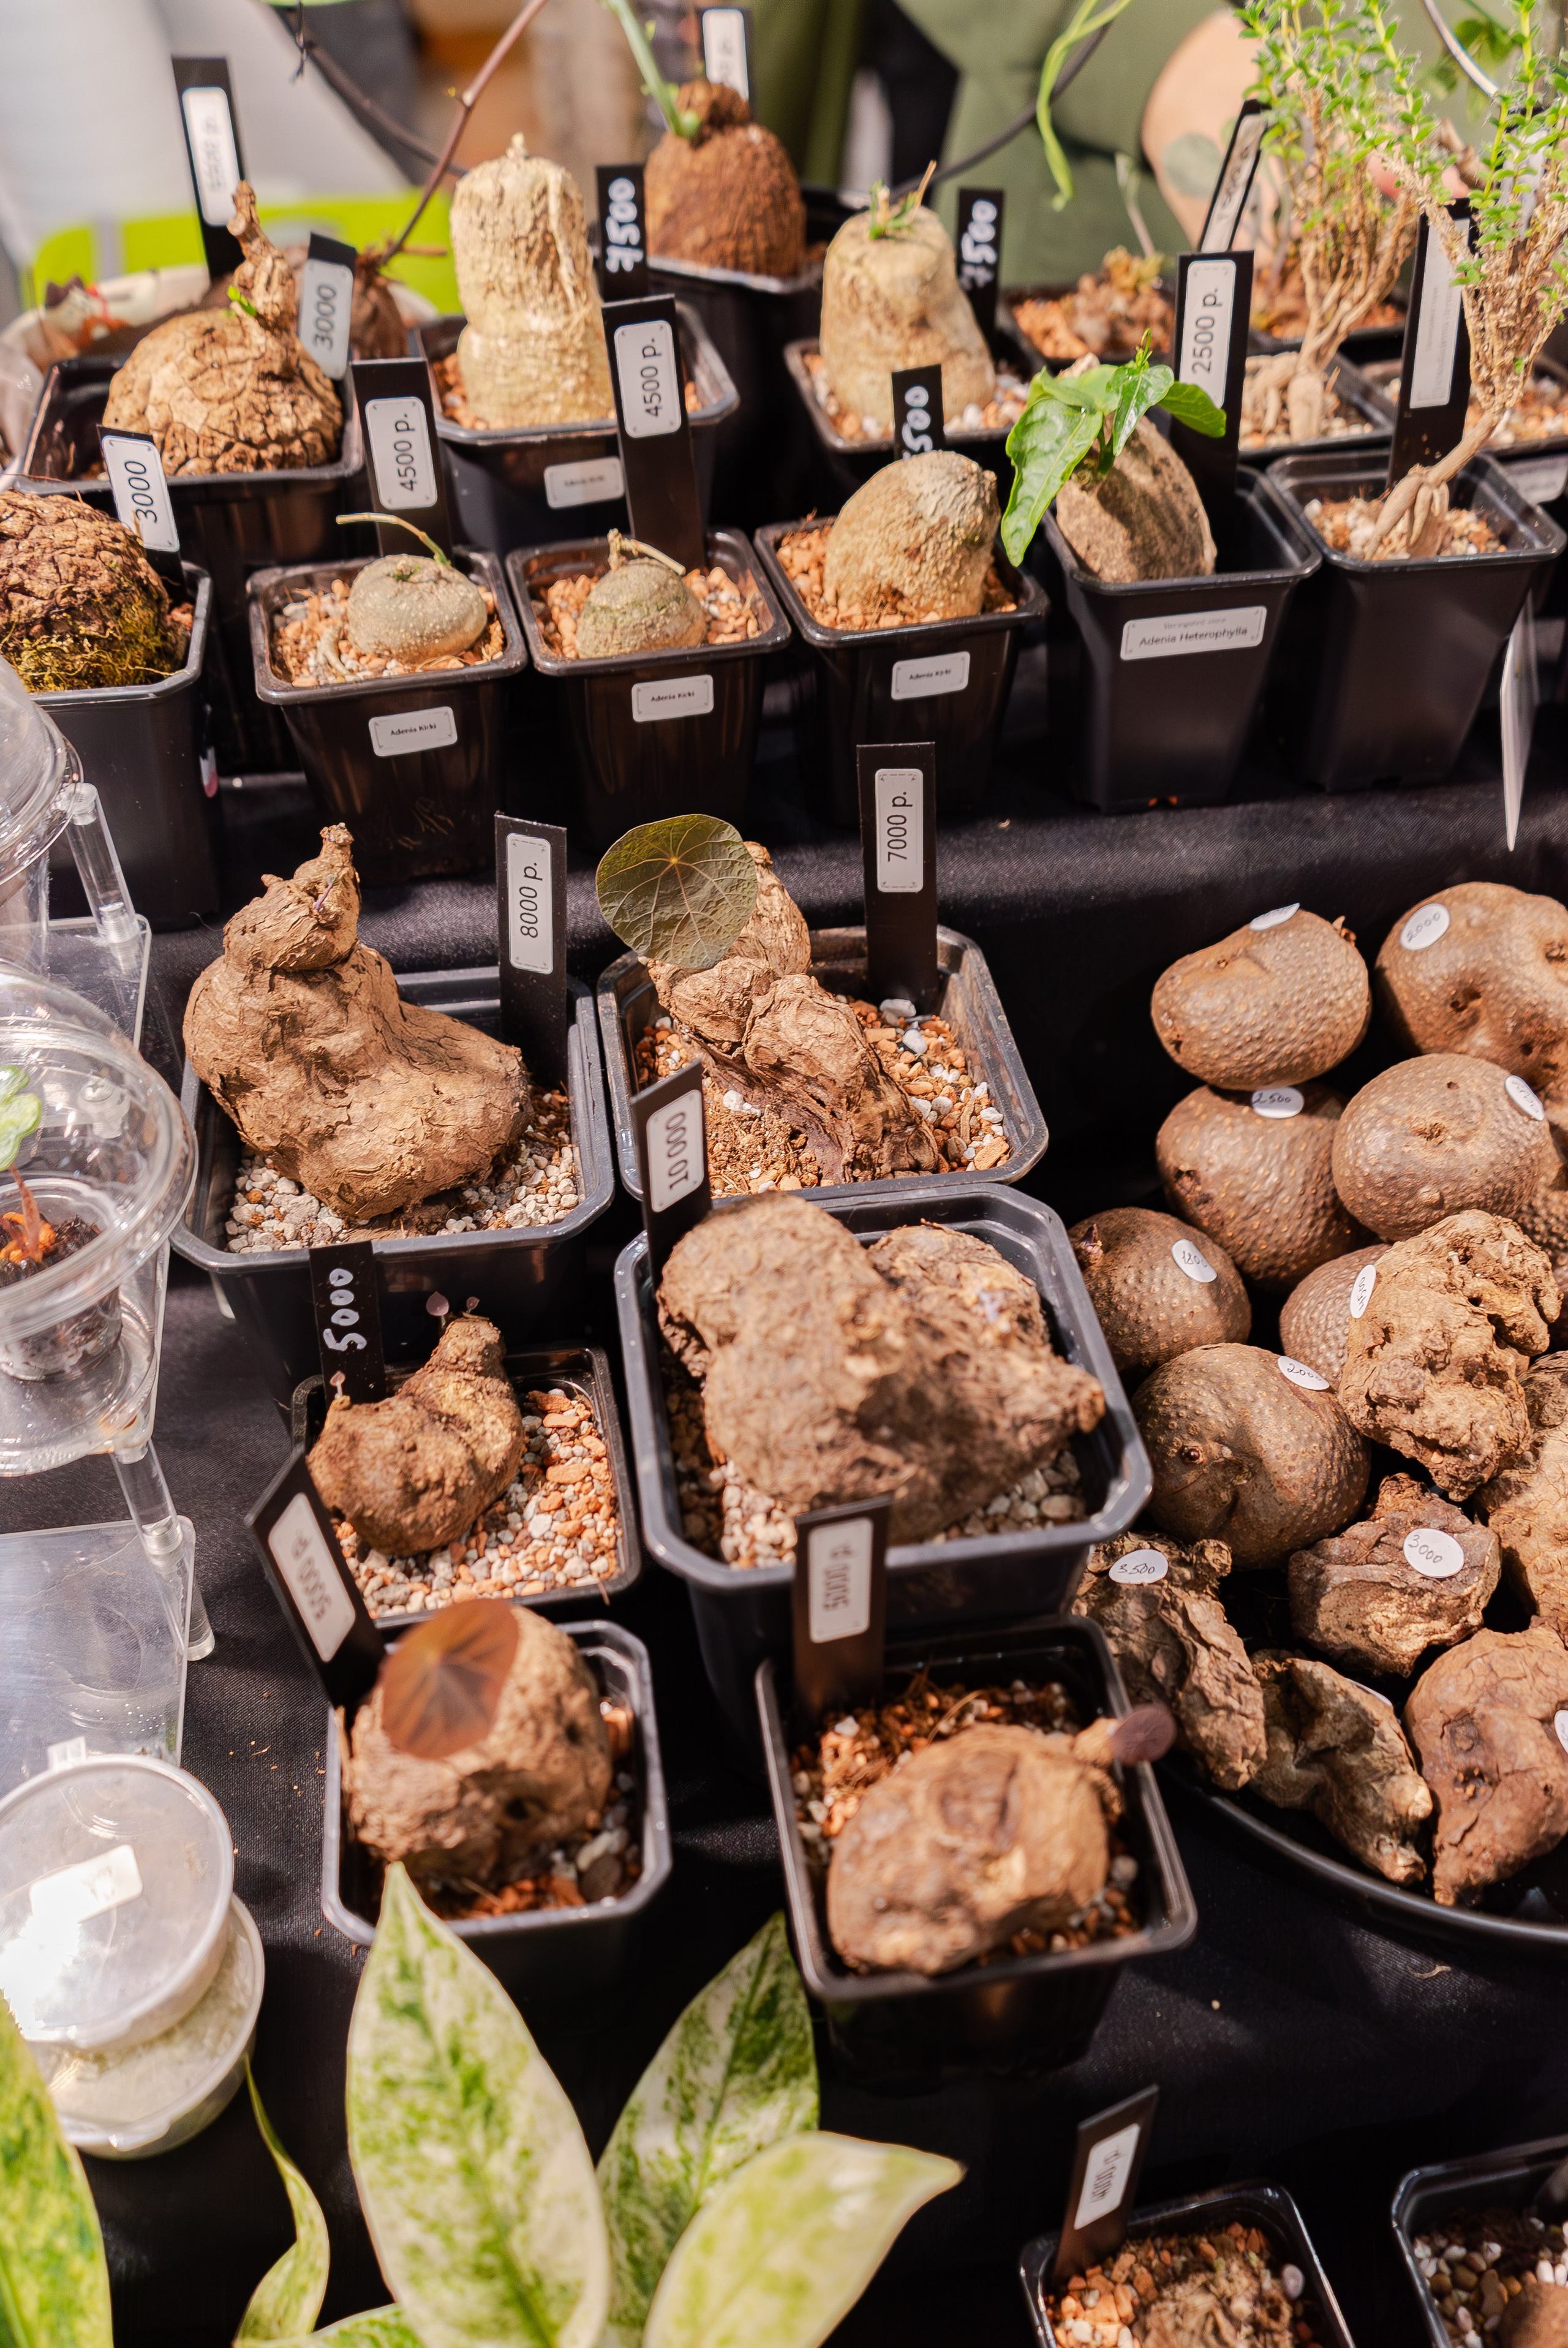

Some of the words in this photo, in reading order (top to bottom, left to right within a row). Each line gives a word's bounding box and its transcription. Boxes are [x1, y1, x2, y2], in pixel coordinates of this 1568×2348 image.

[312, 283, 337, 350] 3000
[1191, 315, 1215, 375] 2500
[639, 366, 663, 417] 4500
[901, 386, 933, 459] 500
[393, 440, 417, 491] 4500
[124, 461, 157, 524] 3000
[1139, 635, 1177, 647] Adenia
[1180, 626, 1248, 644] Heterophylla
[886, 814, 907, 863] 7000
[519, 886, 538, 938] 8000
[323, 1267, 368, 1352] 5000
[1286, 1363, 1322, 1381] 2000
[1408, 1534, 1443, 1563] 3000
